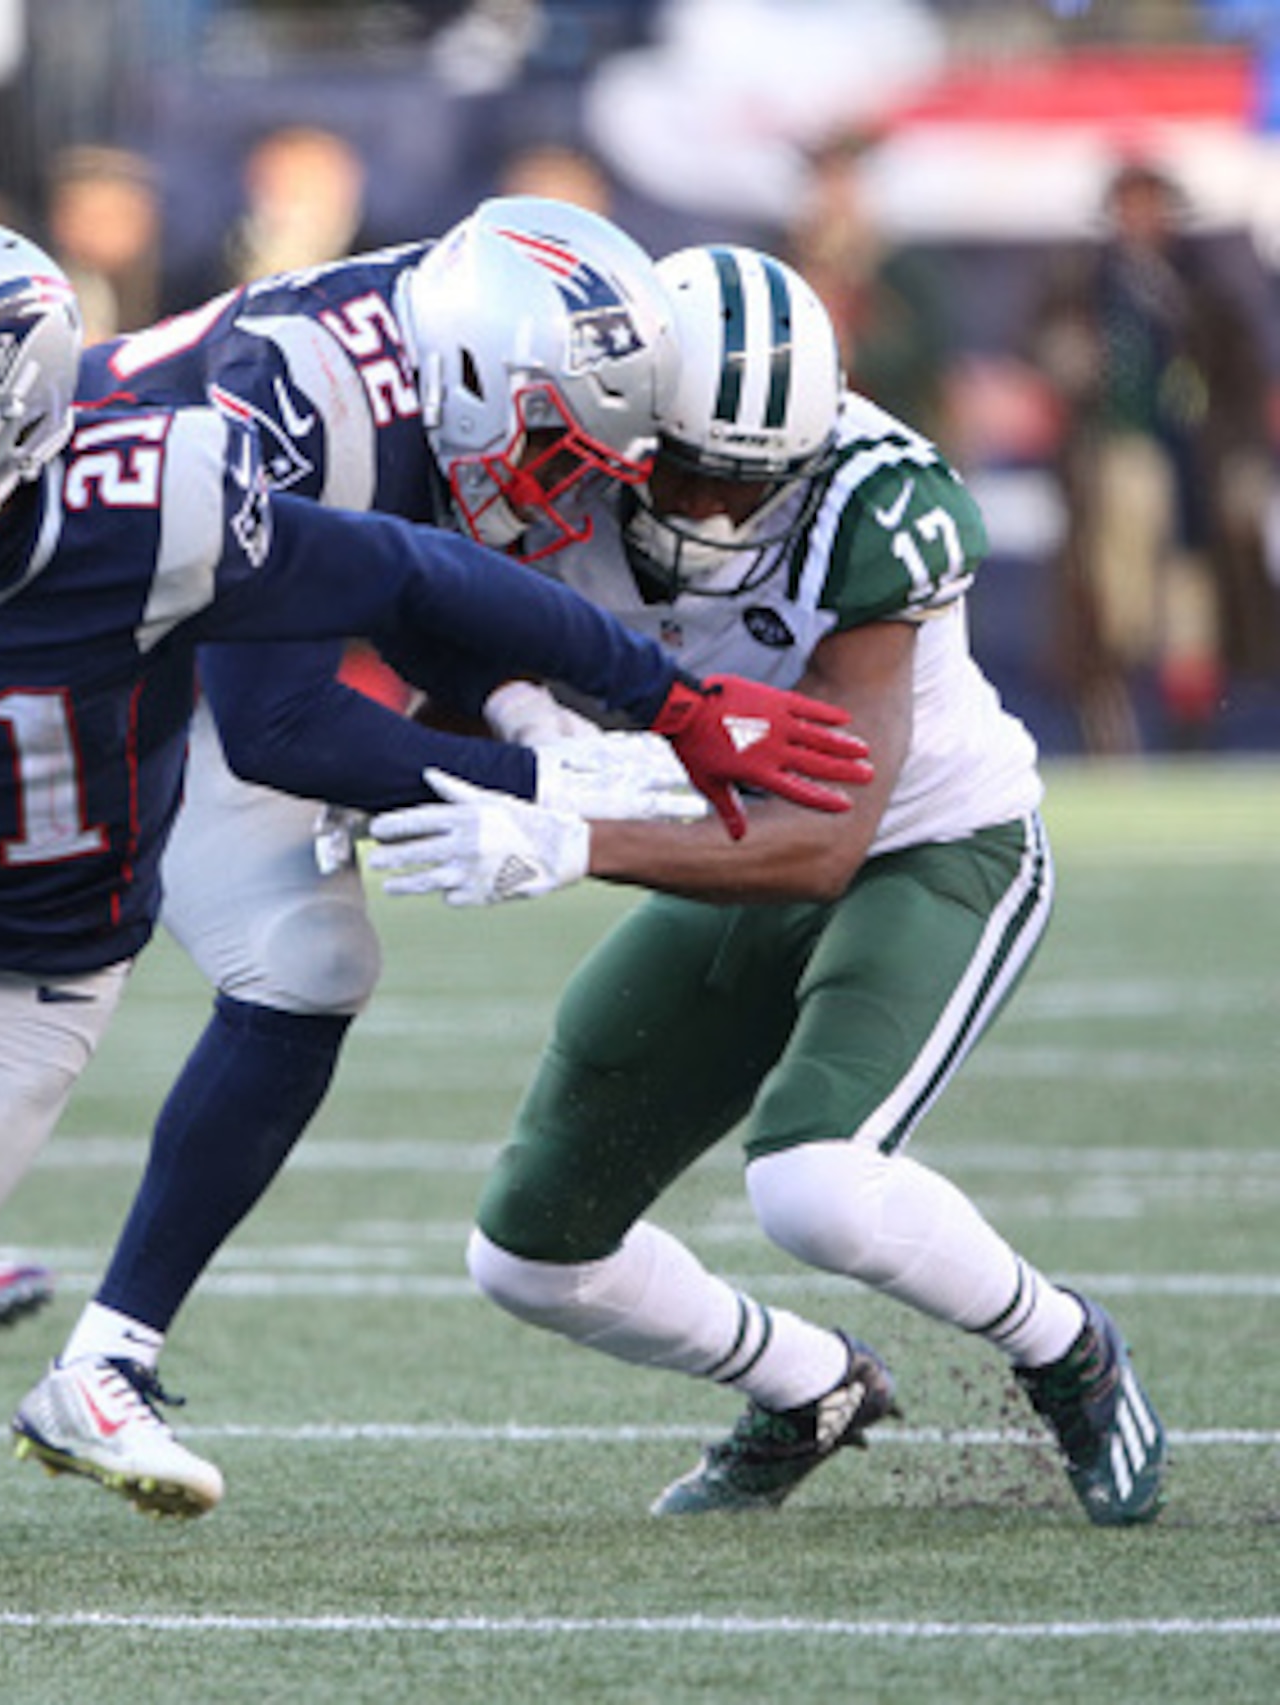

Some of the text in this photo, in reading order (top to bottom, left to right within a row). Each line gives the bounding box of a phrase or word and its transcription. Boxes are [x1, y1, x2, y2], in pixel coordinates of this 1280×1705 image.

[317, 289, 422, 427] 52
[63, 414, 172, 511] 21
[892, 508, 964, 601] 17
